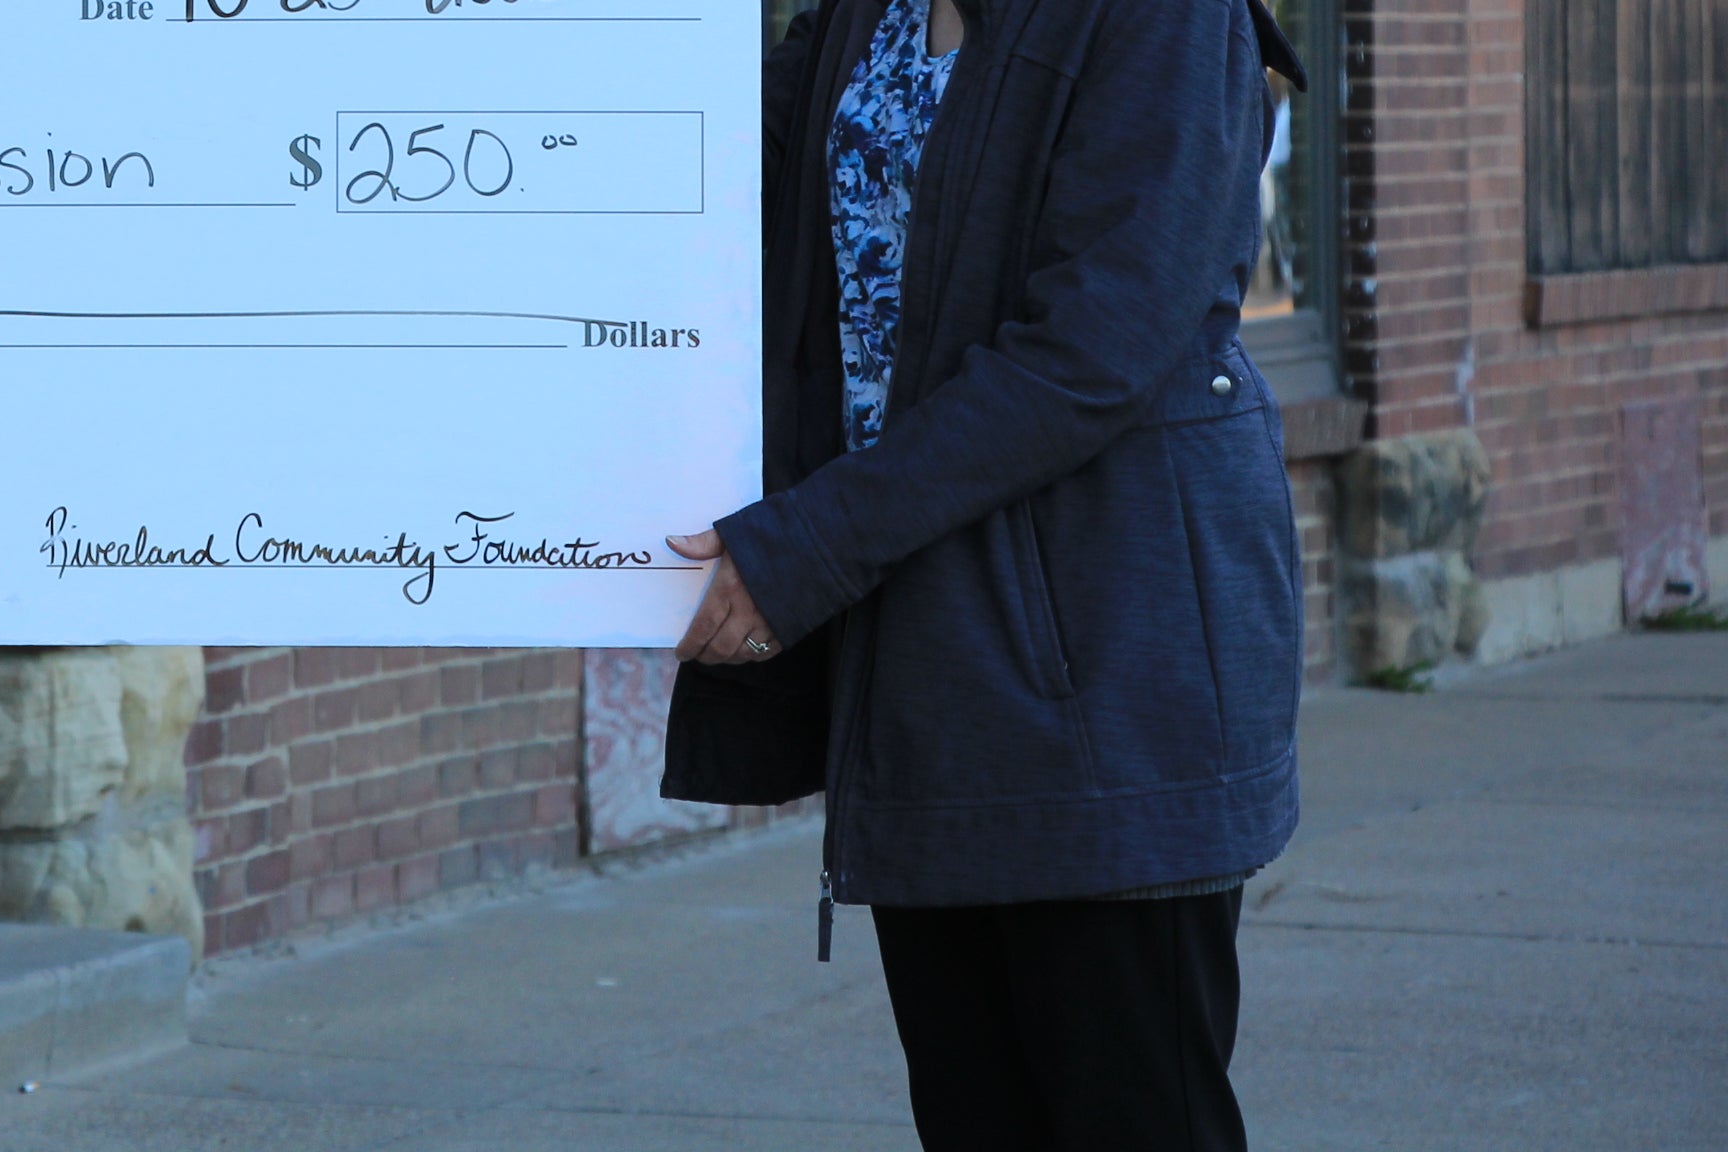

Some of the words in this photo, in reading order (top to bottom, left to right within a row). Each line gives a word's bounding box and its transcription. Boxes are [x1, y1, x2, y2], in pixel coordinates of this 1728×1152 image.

[581, 320, 702, 350] Dollars
[39, 505, 232, 580] Riverland
[234, 512, 437, 605] Community
[443, 511, 652, 569] Foundation
